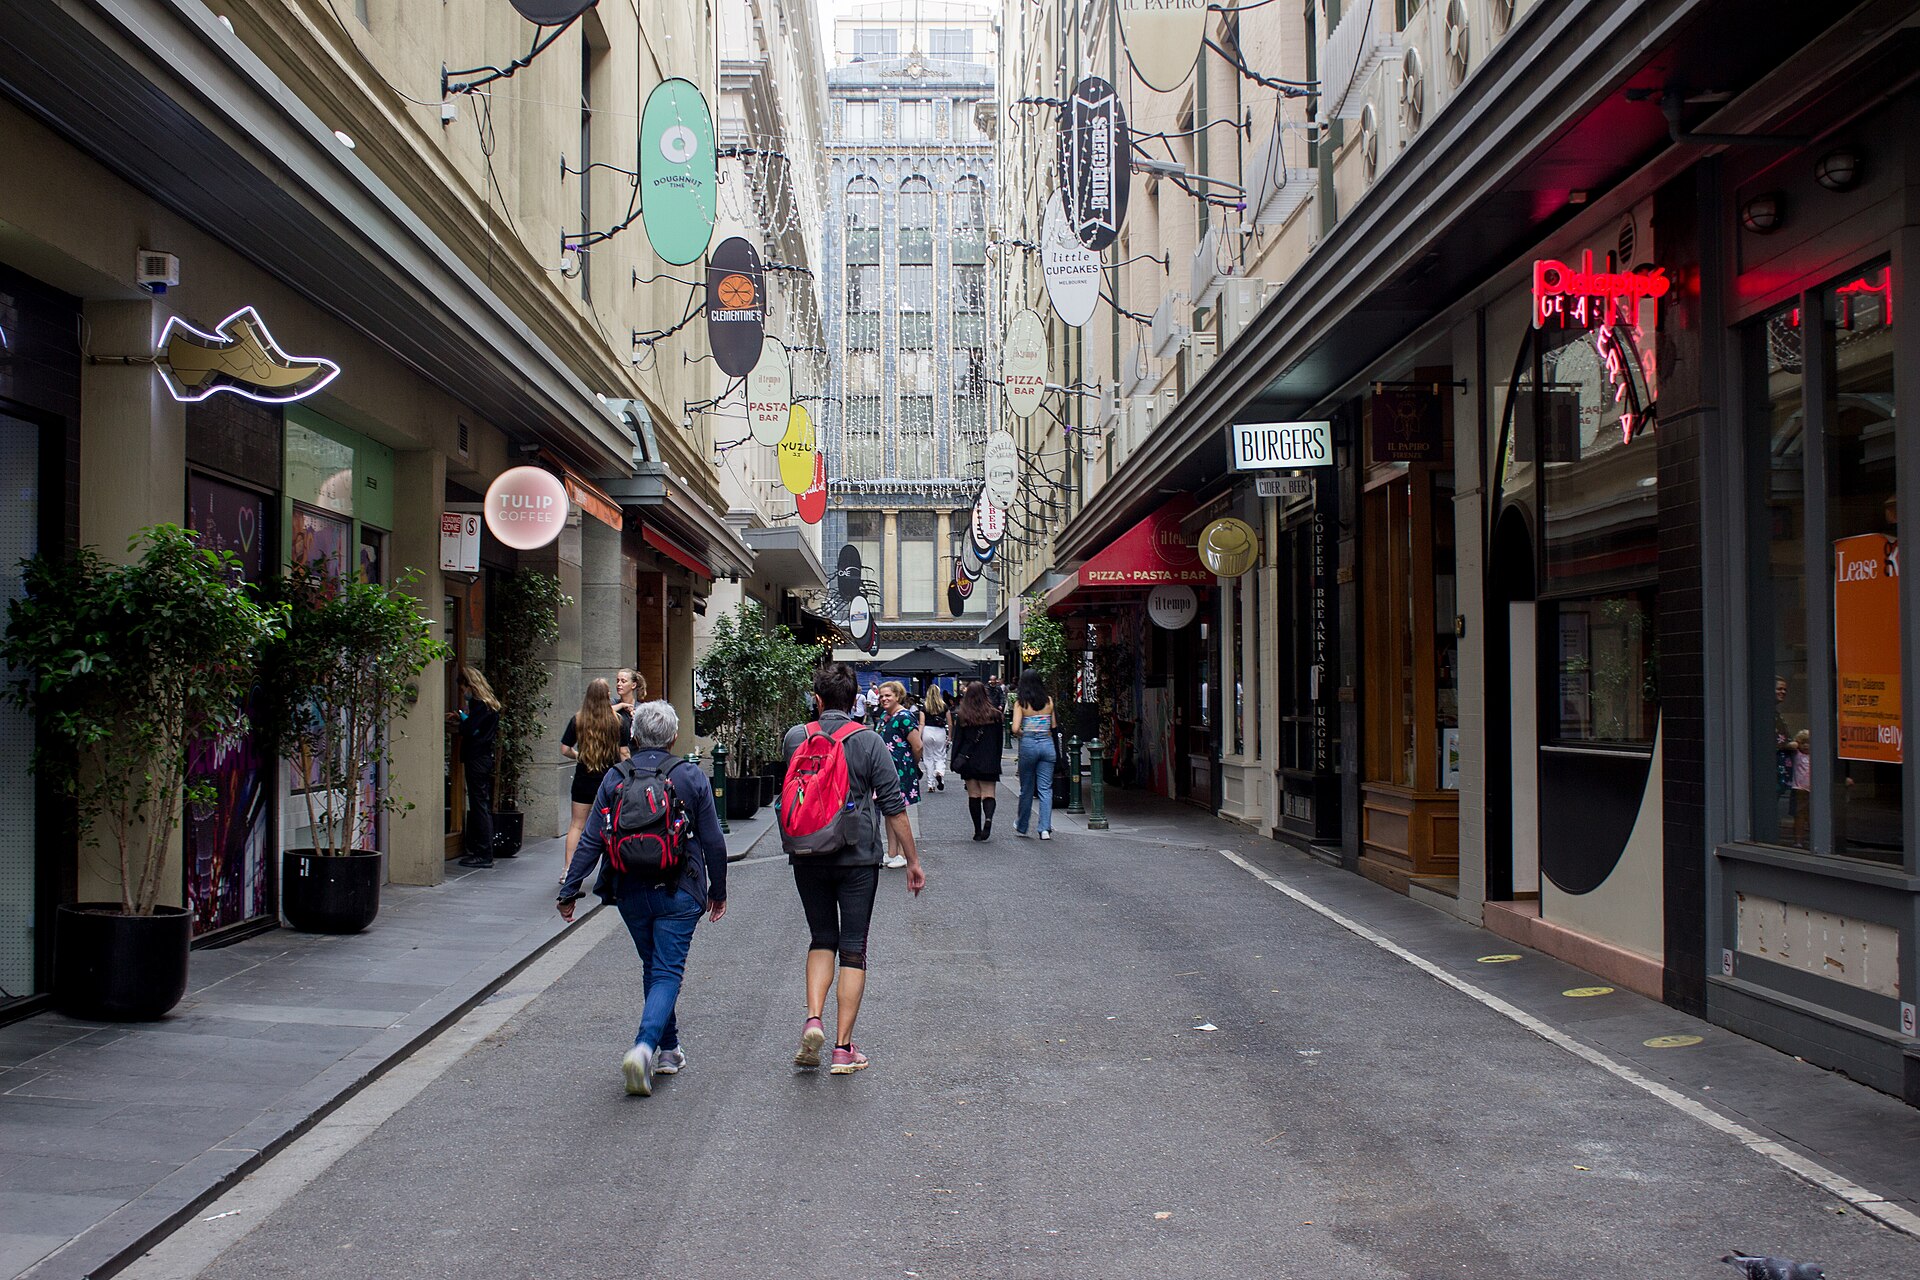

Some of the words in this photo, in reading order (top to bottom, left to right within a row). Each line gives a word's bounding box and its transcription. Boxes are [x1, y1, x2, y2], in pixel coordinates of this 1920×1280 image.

[1091, 116, 1109, 210] BURGERS
[653, 175, 703, 189] DOUGHNUT
[1052, 251, 1090, 263] little
[1046, 264, 1099, 276] CUPCAKES
[711, 309, 763, 323] CLEMENTINE'S
[1014, 387, 1035, 395] BAR
[749, 402, 788, 412] PASTA
[759, 414, 779, 422] BAR
[781, 441, 812, 452] YUZU
[1241, 427, 1326, 462] BURGERS
[1387, 442, 1397, 451] IL
[1398, 442, 1430, 451] PAPIRO
[1259, 478, 1281, 495] CIDER
[1288, 478, 1307, 494] BEER
[499, 493, 554, 509] TULIP
[498, 510, 554, 523] COFFEE
[443, 522, 460, 532] ZONE
[1160, 530, 1167, 545] il
[1314, 513, 1324, 576] COFFEE
[1837, 551, 1878, 582] Lease
[1133, 570, 1172, 581] PASTA
[1180, 570, 1207, 581] BAR
[1154, 596, 1161, 611] il
[1162, 596, 1191, 613] tempo
[1316, 588, 1327, 685] BREAKFAST
[1317, 706, 1327, 770] URGERS
